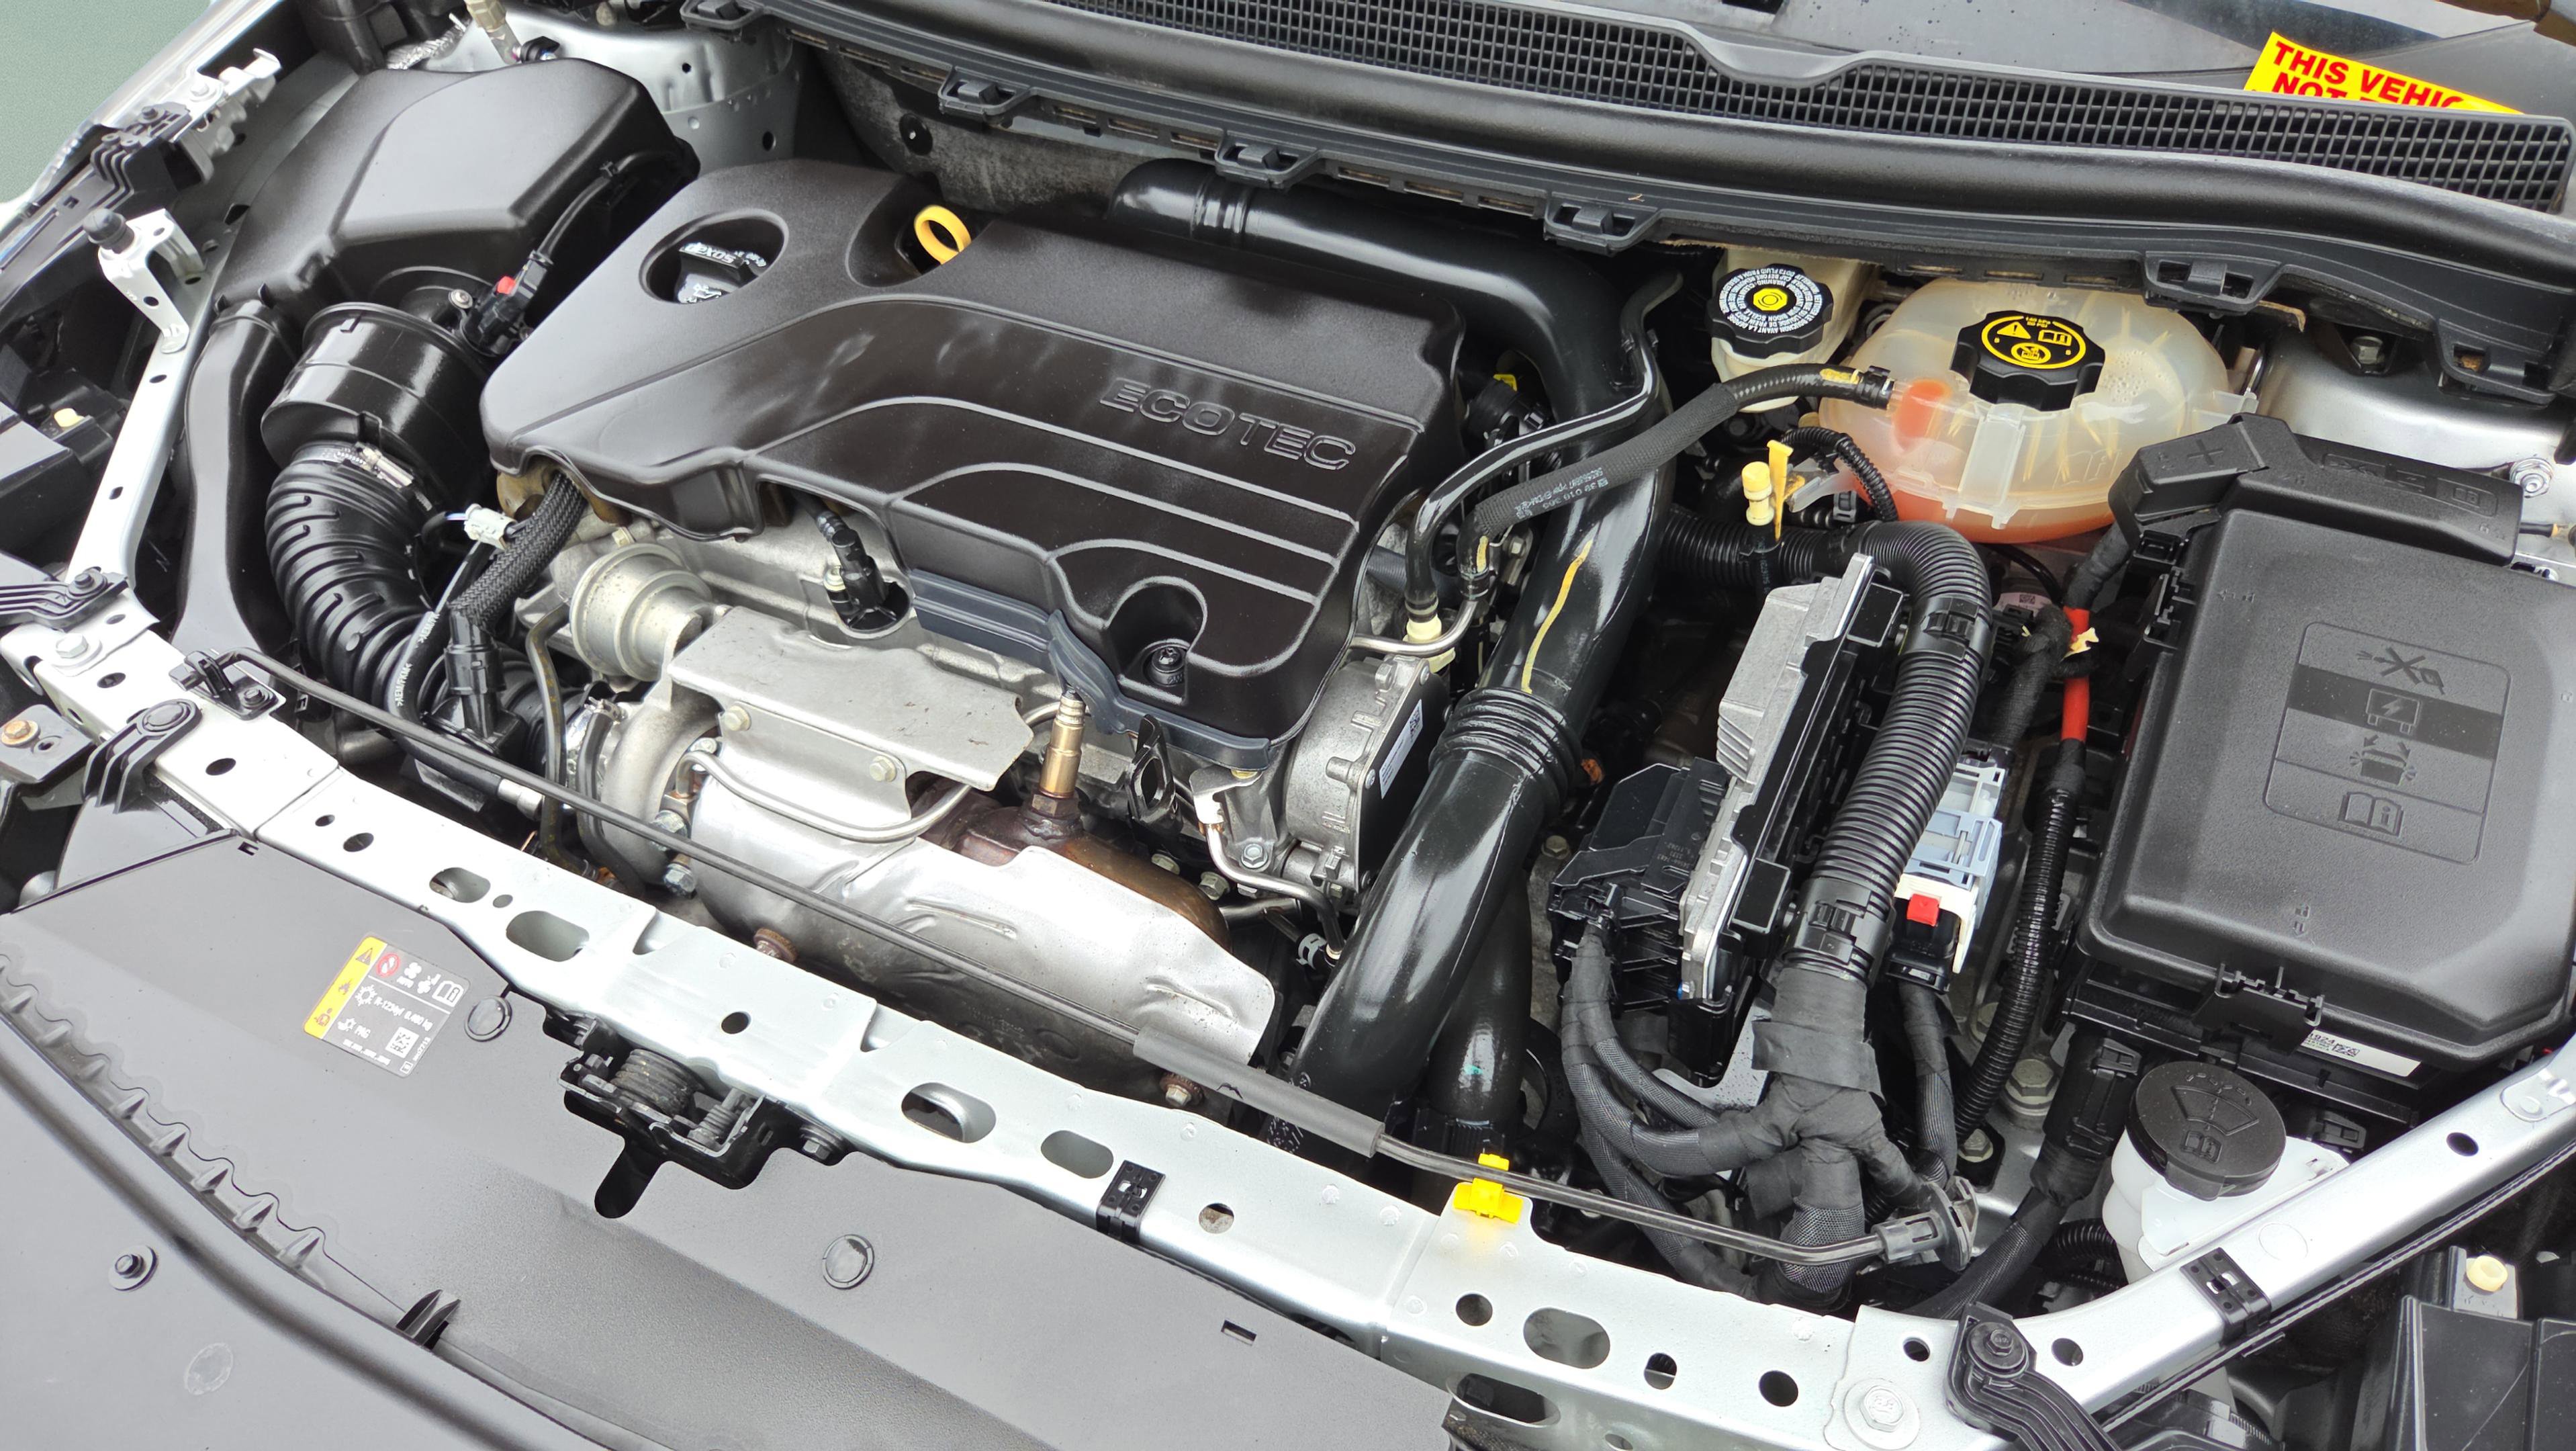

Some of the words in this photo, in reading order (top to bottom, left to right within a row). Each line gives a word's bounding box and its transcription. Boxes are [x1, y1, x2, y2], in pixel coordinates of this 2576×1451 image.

[2273, 41, 2349, 84] THIS
[2360, 69, 2464, 108] VEHI
[1099, 378, 1356, 470] ECOTEC
